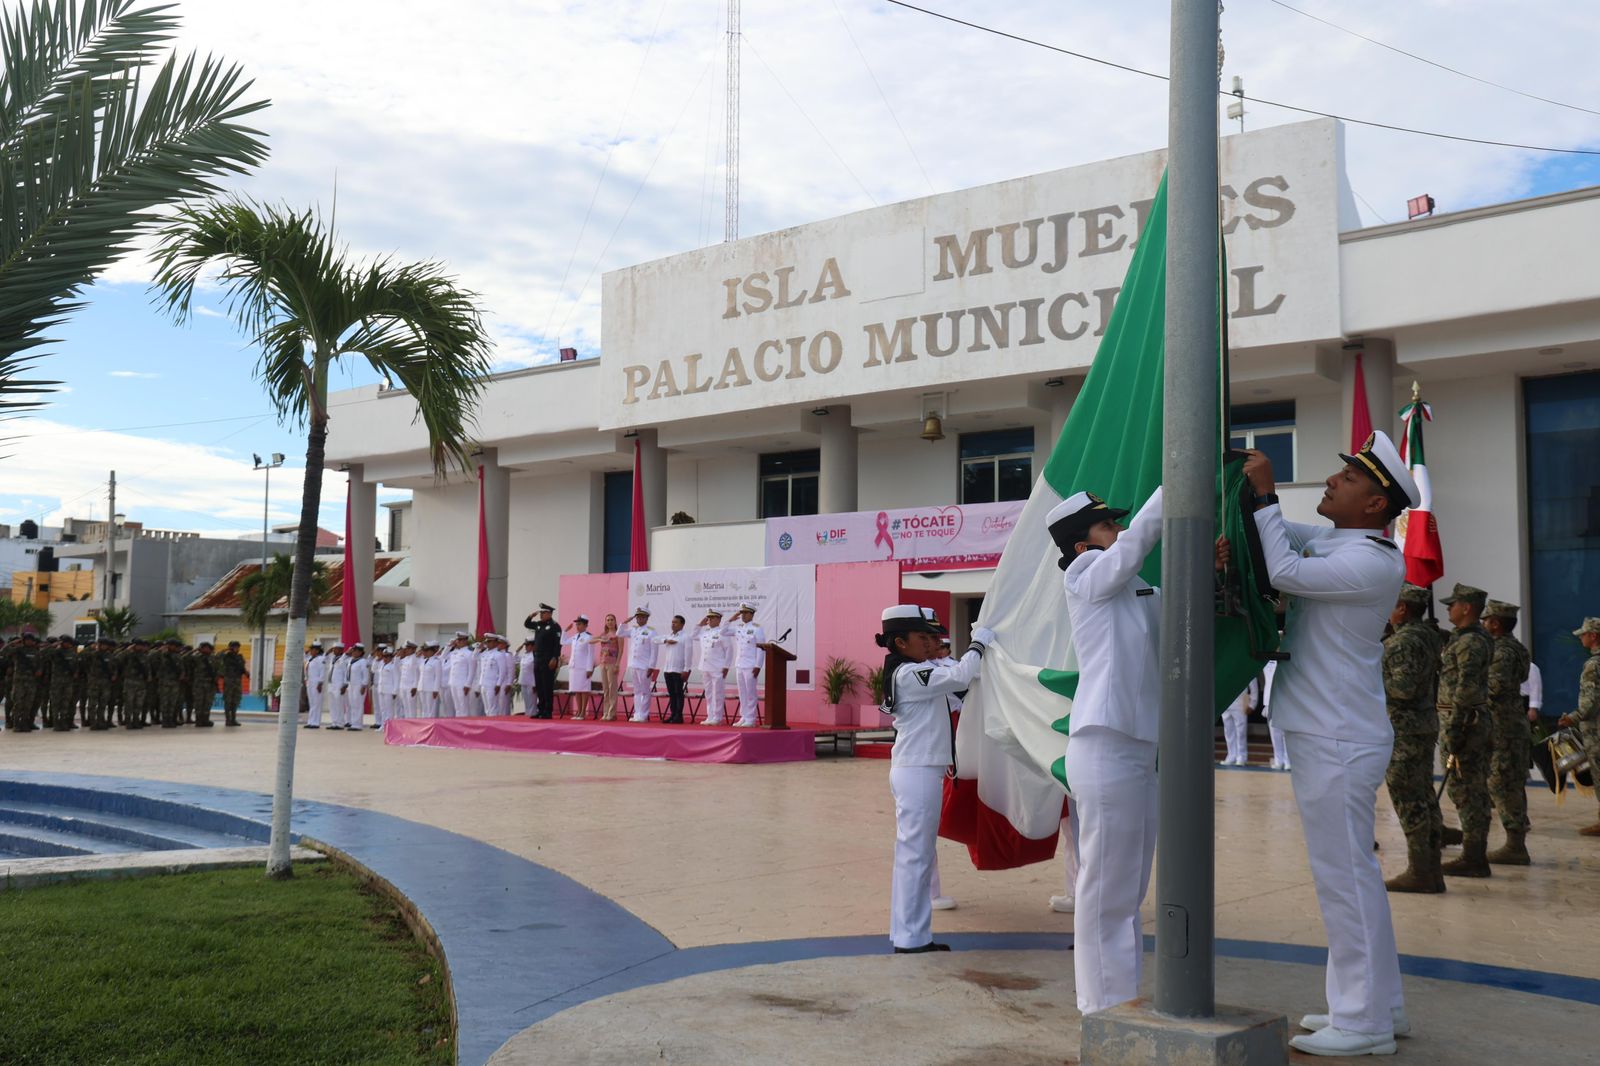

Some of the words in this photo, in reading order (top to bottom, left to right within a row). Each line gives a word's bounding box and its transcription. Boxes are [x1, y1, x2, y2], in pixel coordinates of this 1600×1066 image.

[722, 257, 852, 320] ISLA
[933, 175, 1297, 282] MUJES
[622, 330, 843, 405] PALACIO
[862, 265, 1287, 369] MUNICIL
[830, 528, 847, 539] DIF
[900, 530, 913, 539] NO
[914, 530, 924, 538] TE
[926, 528, 955, 538] TOQUE
[646, 583, 671, 593] Marina
[703, 582, 725, 590] Marina
